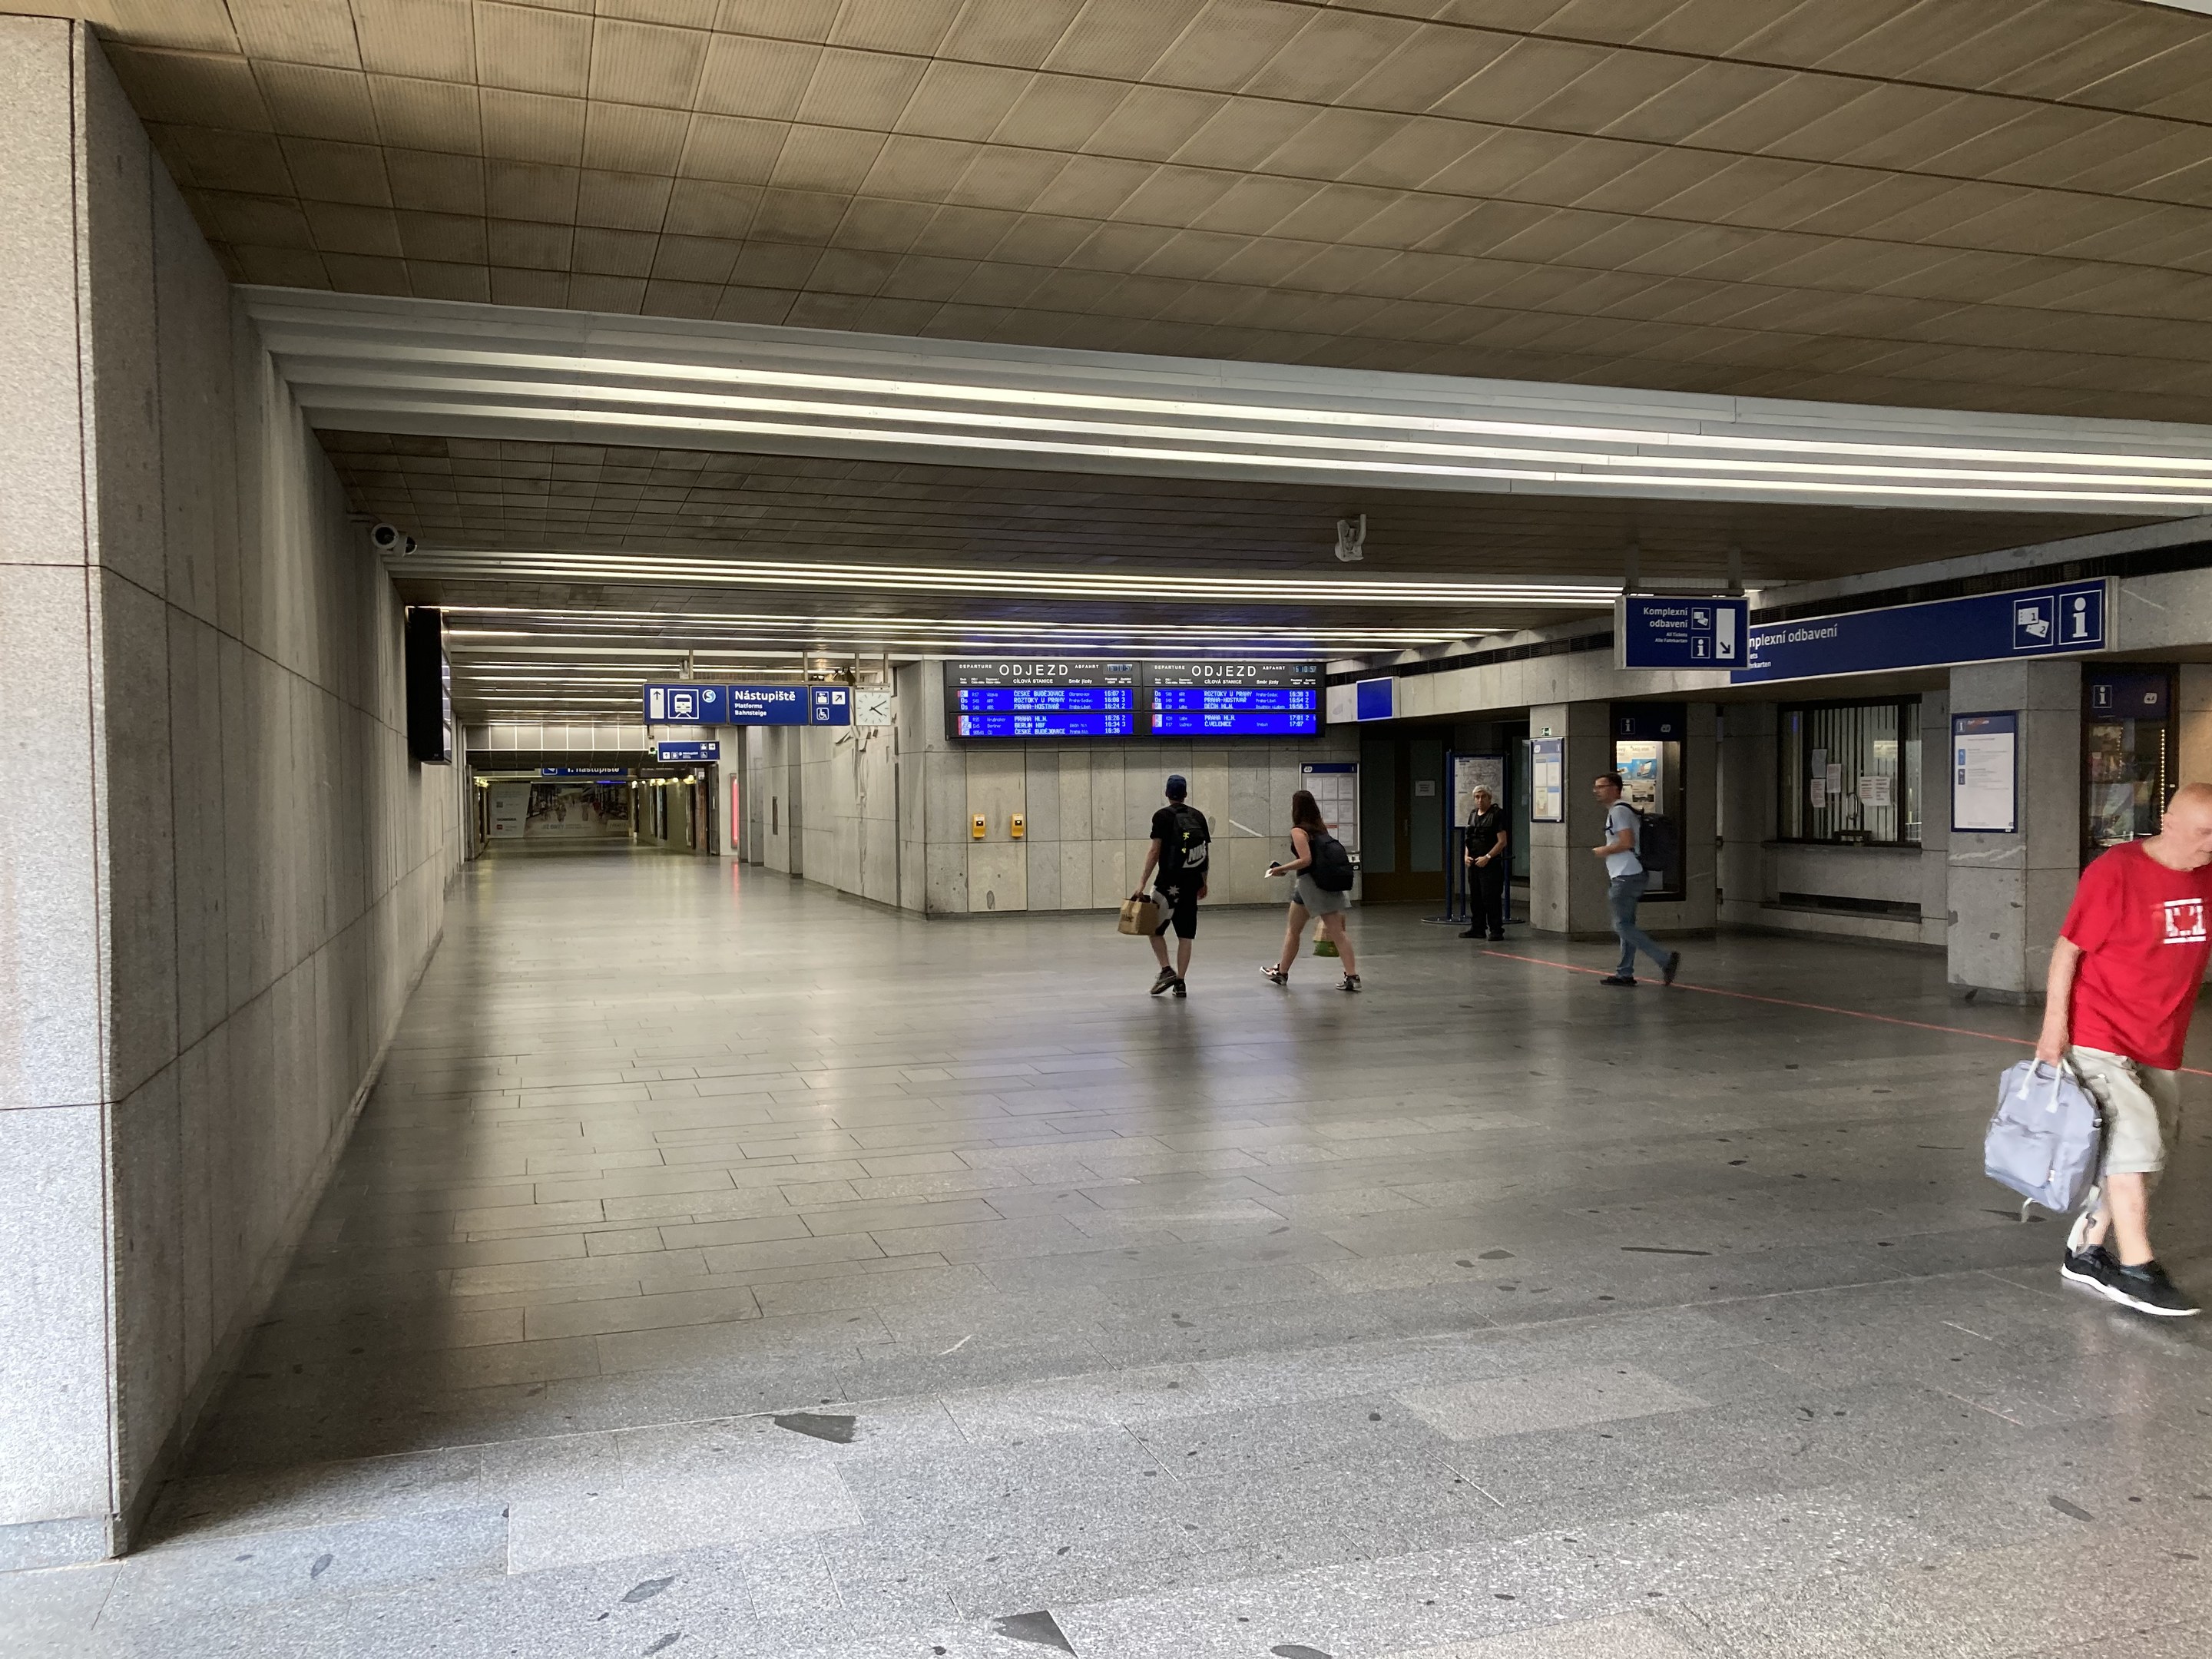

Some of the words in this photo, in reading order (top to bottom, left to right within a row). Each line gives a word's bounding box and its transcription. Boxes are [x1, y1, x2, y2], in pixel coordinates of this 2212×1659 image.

[1644, 608, 1688, 617] Komplexní
[1750, 630, 1786, 650] mplexní
[1788, 624, 1837, 642] odbavení
[999, 664, 1068, 676] ODJEZD
[1191, 665, 1257, 676] ODJEZD
[735, 690, 796, 703] Nástupiště
